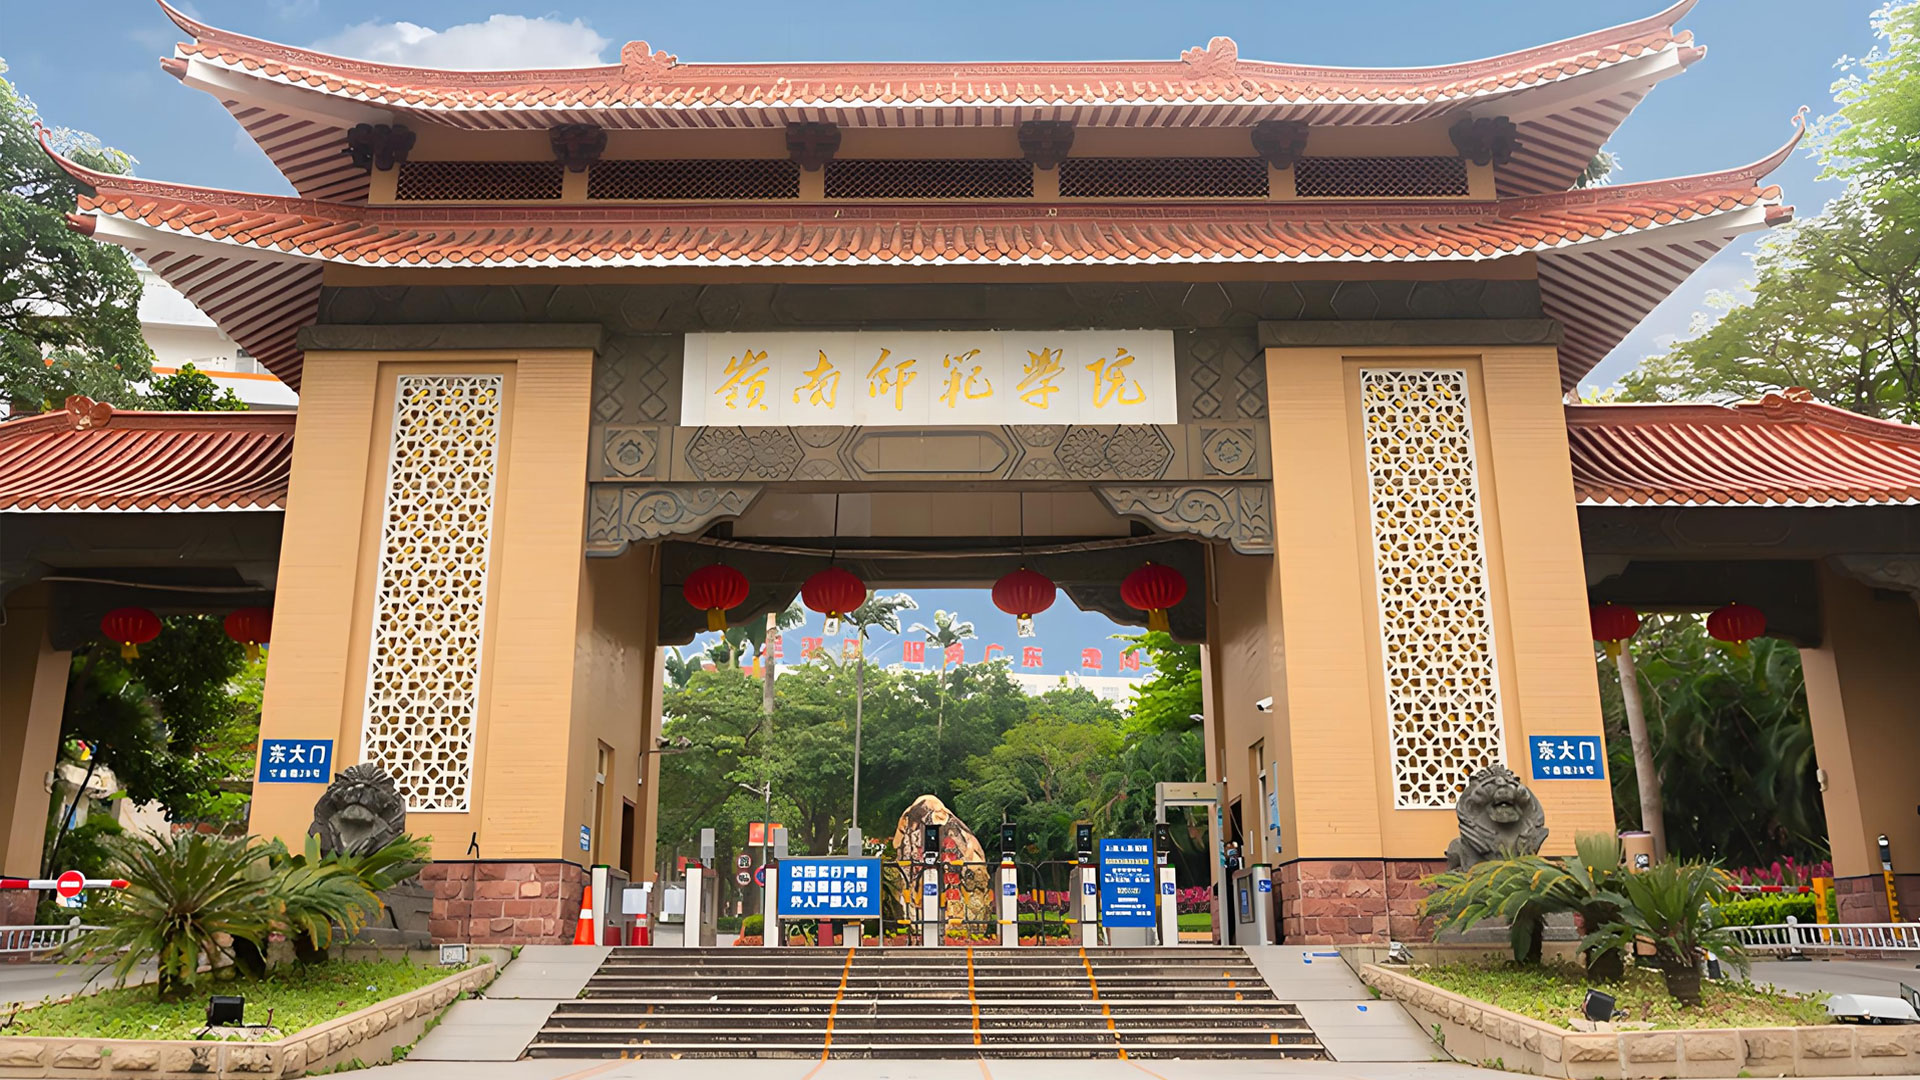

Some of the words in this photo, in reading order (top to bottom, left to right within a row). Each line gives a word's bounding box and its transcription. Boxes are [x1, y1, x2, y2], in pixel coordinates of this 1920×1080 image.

[268, 743, 327, 764] 东大门
[1537, 740, 1596, 761] 东大门
